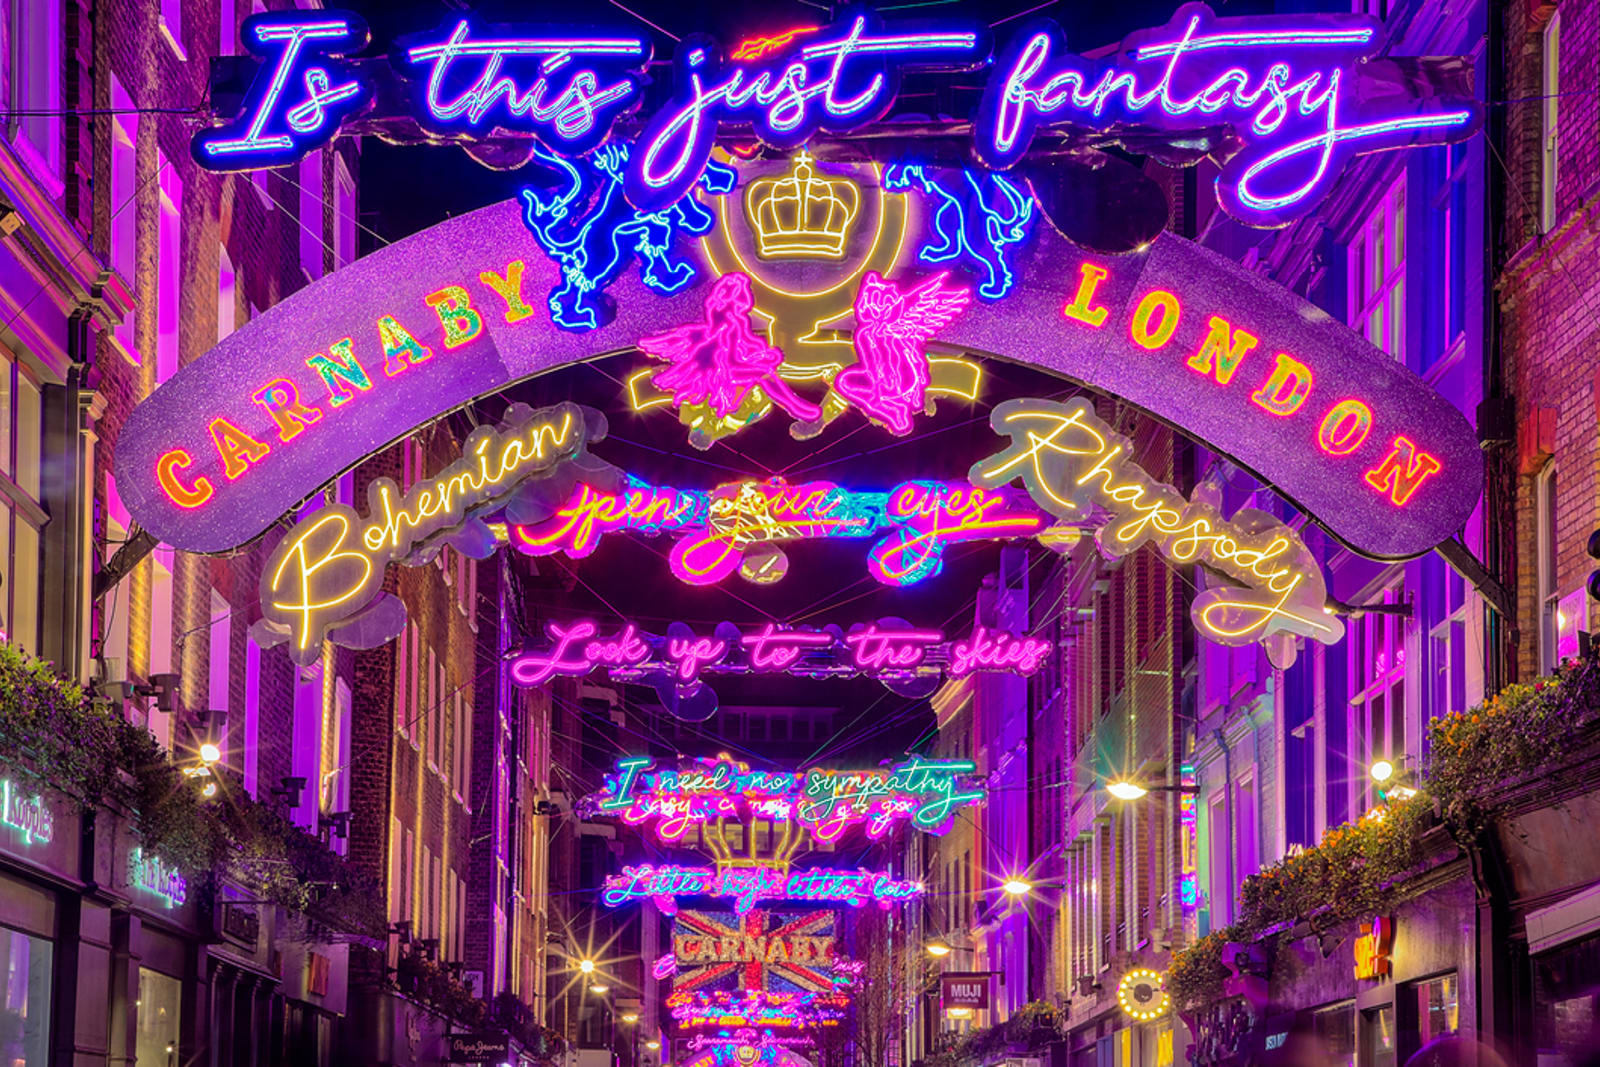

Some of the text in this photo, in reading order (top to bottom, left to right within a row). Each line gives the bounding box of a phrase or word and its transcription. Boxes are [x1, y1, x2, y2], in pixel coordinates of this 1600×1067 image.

[204, 14, 1471, 210] Is this just fantasy
[155, 258, 536, 510] CARNABY
[1062, 262, 1442, 508] LONDON
[272, 413, 572, 649] Bohemian
[682, 484, 869, 577] your
[879, 488, 1040, 578] eyes
[982, 408, 1333, 636] Rhapsody
[511, 623, 1051, 683] Look up to the skies
[602, 758, 651, 808] I
[658, 768, 731, 792] need
[751, 776, 790, 791] no
[802, 760, 985, 824] sympathy
[674, 934, 836, 964] CARNABY
[951, 984, 982, 998] MUJI
